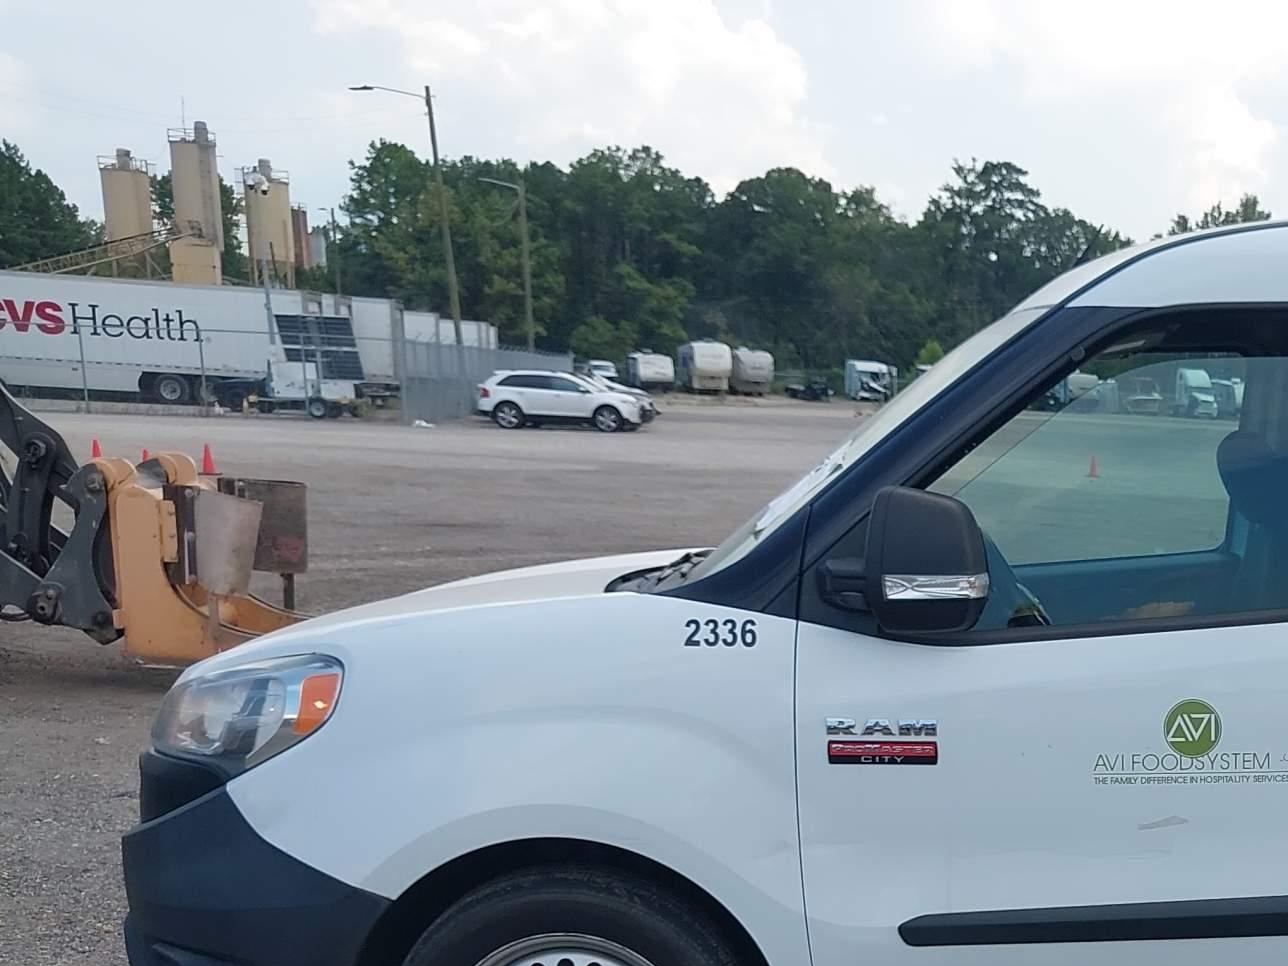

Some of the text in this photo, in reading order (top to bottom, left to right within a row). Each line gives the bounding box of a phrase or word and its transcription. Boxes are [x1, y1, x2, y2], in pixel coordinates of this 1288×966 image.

[0, 299, 204, 342] VS Health
[684, 618, 757, 647] 2336
[826, 717, 938, 736] RAM
[1167, 713, 1216, 742] AVI
[1093, 753, 1125, 771] AVI
[1094, 776, 1109, 785] THE
[1110, 776, 1139, 785] FAMILY
[1140, 775, 1188, 785] DIFFERENCE
[1190, 775, 1198, 784] IN
[1200, 774, 1251, 784] HOSPITALITY
